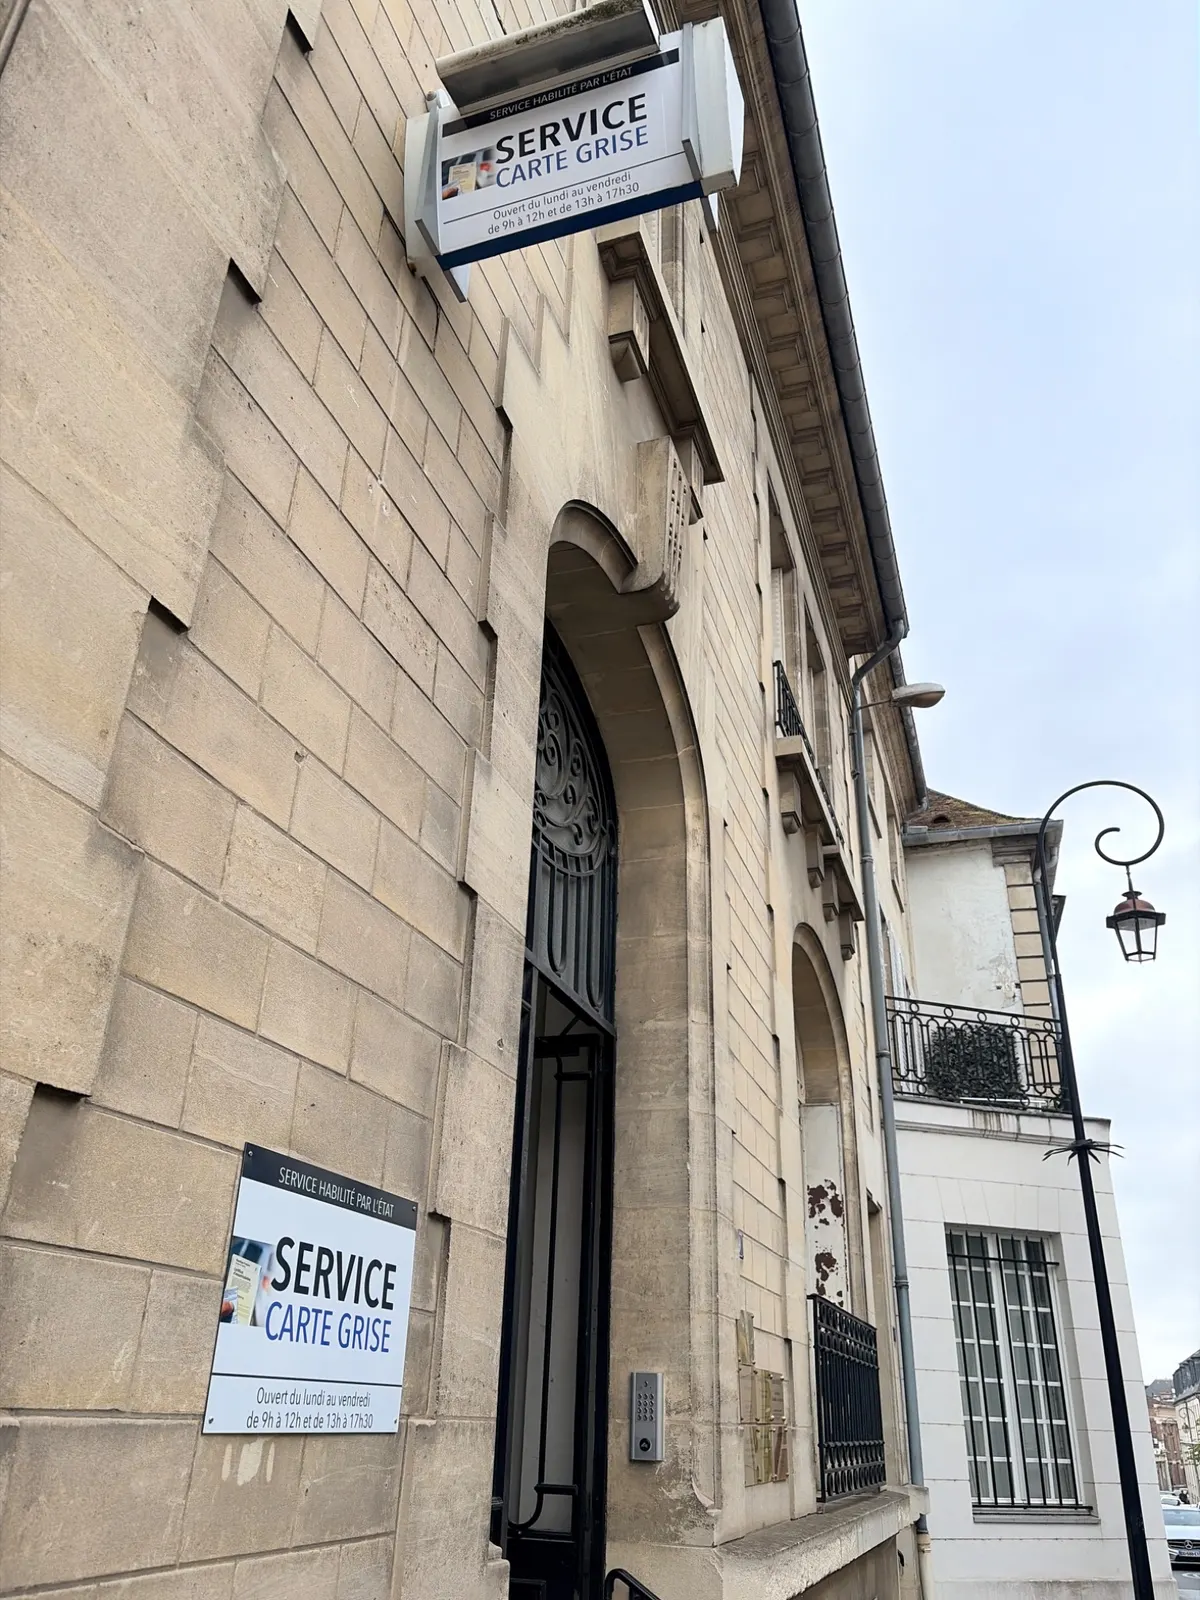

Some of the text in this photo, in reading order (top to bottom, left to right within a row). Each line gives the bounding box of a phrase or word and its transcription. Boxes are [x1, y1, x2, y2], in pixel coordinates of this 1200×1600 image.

[490, 66, 633, 120] SERVICE HABILITÉ PAR L'ÉTAT
[495, 93, 648, 164] SERVICE
[496, 125, 649, 189] CARTE GRISE
[488, 181, 640, 235] de 9h à 12h et de 13h à 17h30
[493, 171, 631, 220] Ouvert du lundi au vendredi
[279, 1166, 395, 1218] SERVICE HABILITÉ PAR L'ÉTAT
[270, 1236, 397, 1311] SERVICE
[265, 1301, 392, 1353] CARTE GRISE
[246, 1410, 374, 1429] de 9h à 12h et de 13h à 17h30
[256, 1386, 371, 1408] Ouvert du lundi au vendredi
